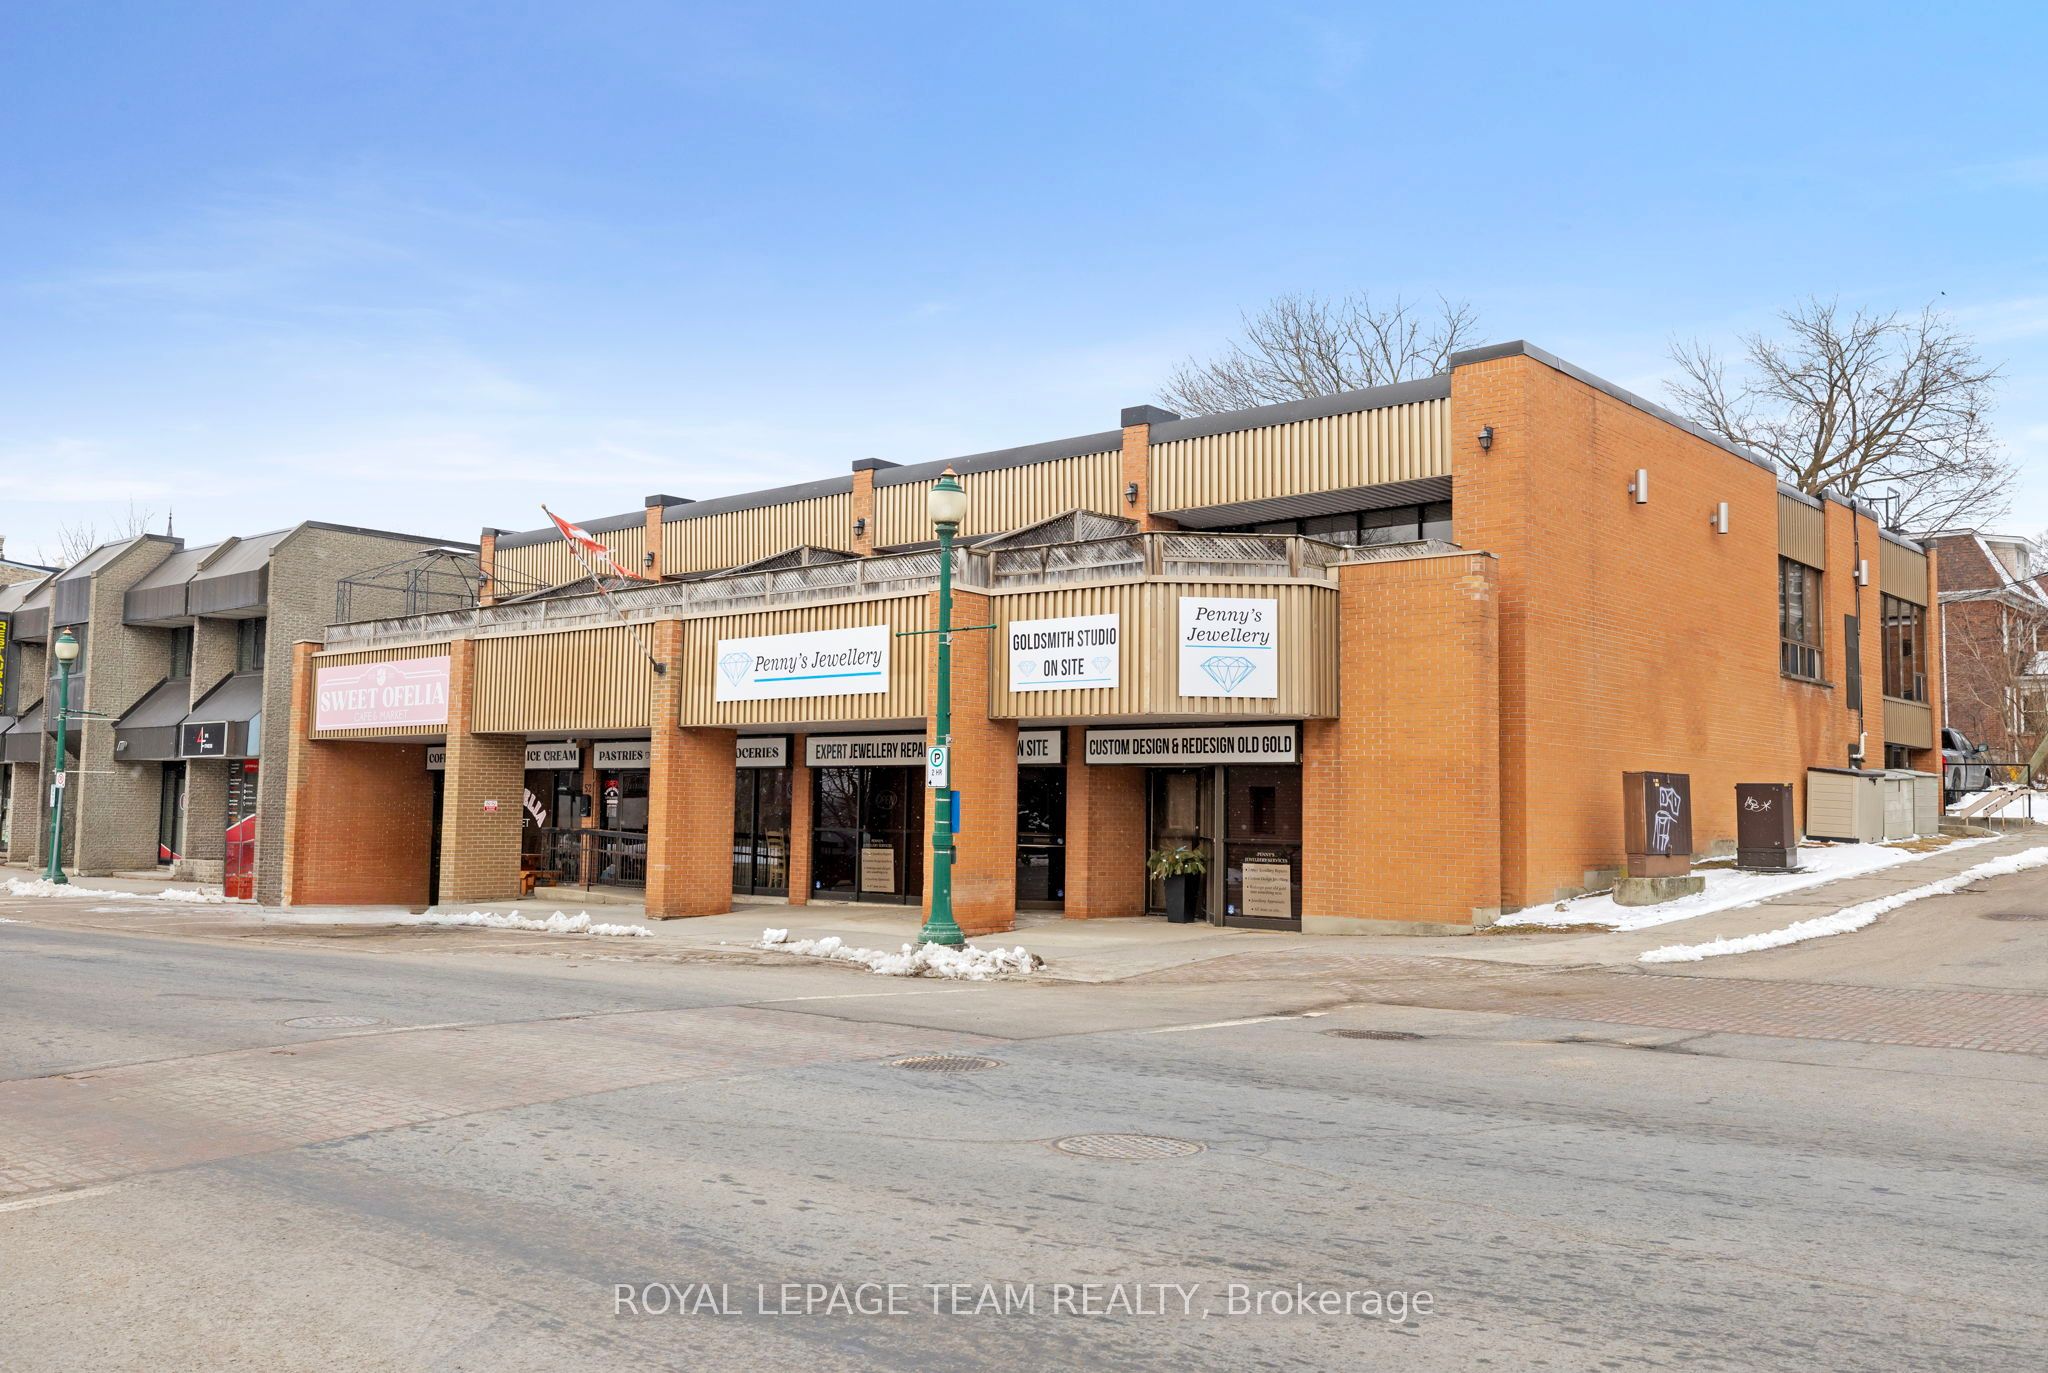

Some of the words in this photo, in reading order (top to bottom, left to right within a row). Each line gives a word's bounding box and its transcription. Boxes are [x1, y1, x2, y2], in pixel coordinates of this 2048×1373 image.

[1195, 607, 1262, 625] Penny's
[1013, 631, 1074, 651] GOLDSMITH
[1077, 628, 1117, 647] STUDIO
[1187, 627, 1270, 646] Jewellery
[754, 653, 808, 673] Penny's
[812, 648, 882, 669] Jewellery
[1043, 660, 1058, 677] ON
[1061, 658, 1084, 676] SITE
[320, 687, 378, 712] SWEET
[382, 681, 444, 708] OFELIA
[380, 709, 408, 721] MARKET
[736, 747, 779, 759] OCERIES
[816, 744, 847, 759] EXPERT
[849, 743, 899, 759] JEWELLERY
[901, 742, 926, 758] REPAI
[1027, 739, 1049, 756] SITE
[1089, 739, 1130, 755] CUSTOM
[1133, 738, 1170, 755] DESIGN
[1172, 738, 1178, 754] &
[1182, 737, 1235, 754] REDESIGN
[1238, 736, 1259, 753] OLD
[1262, 736, 1292, 753] GOLD
[527, 751, 541, 761] ICE
[543, 750, 577, 761] CREAM
[599, 750, 643, 761] PASTRIES
[584, 783, 592, 793] 52
